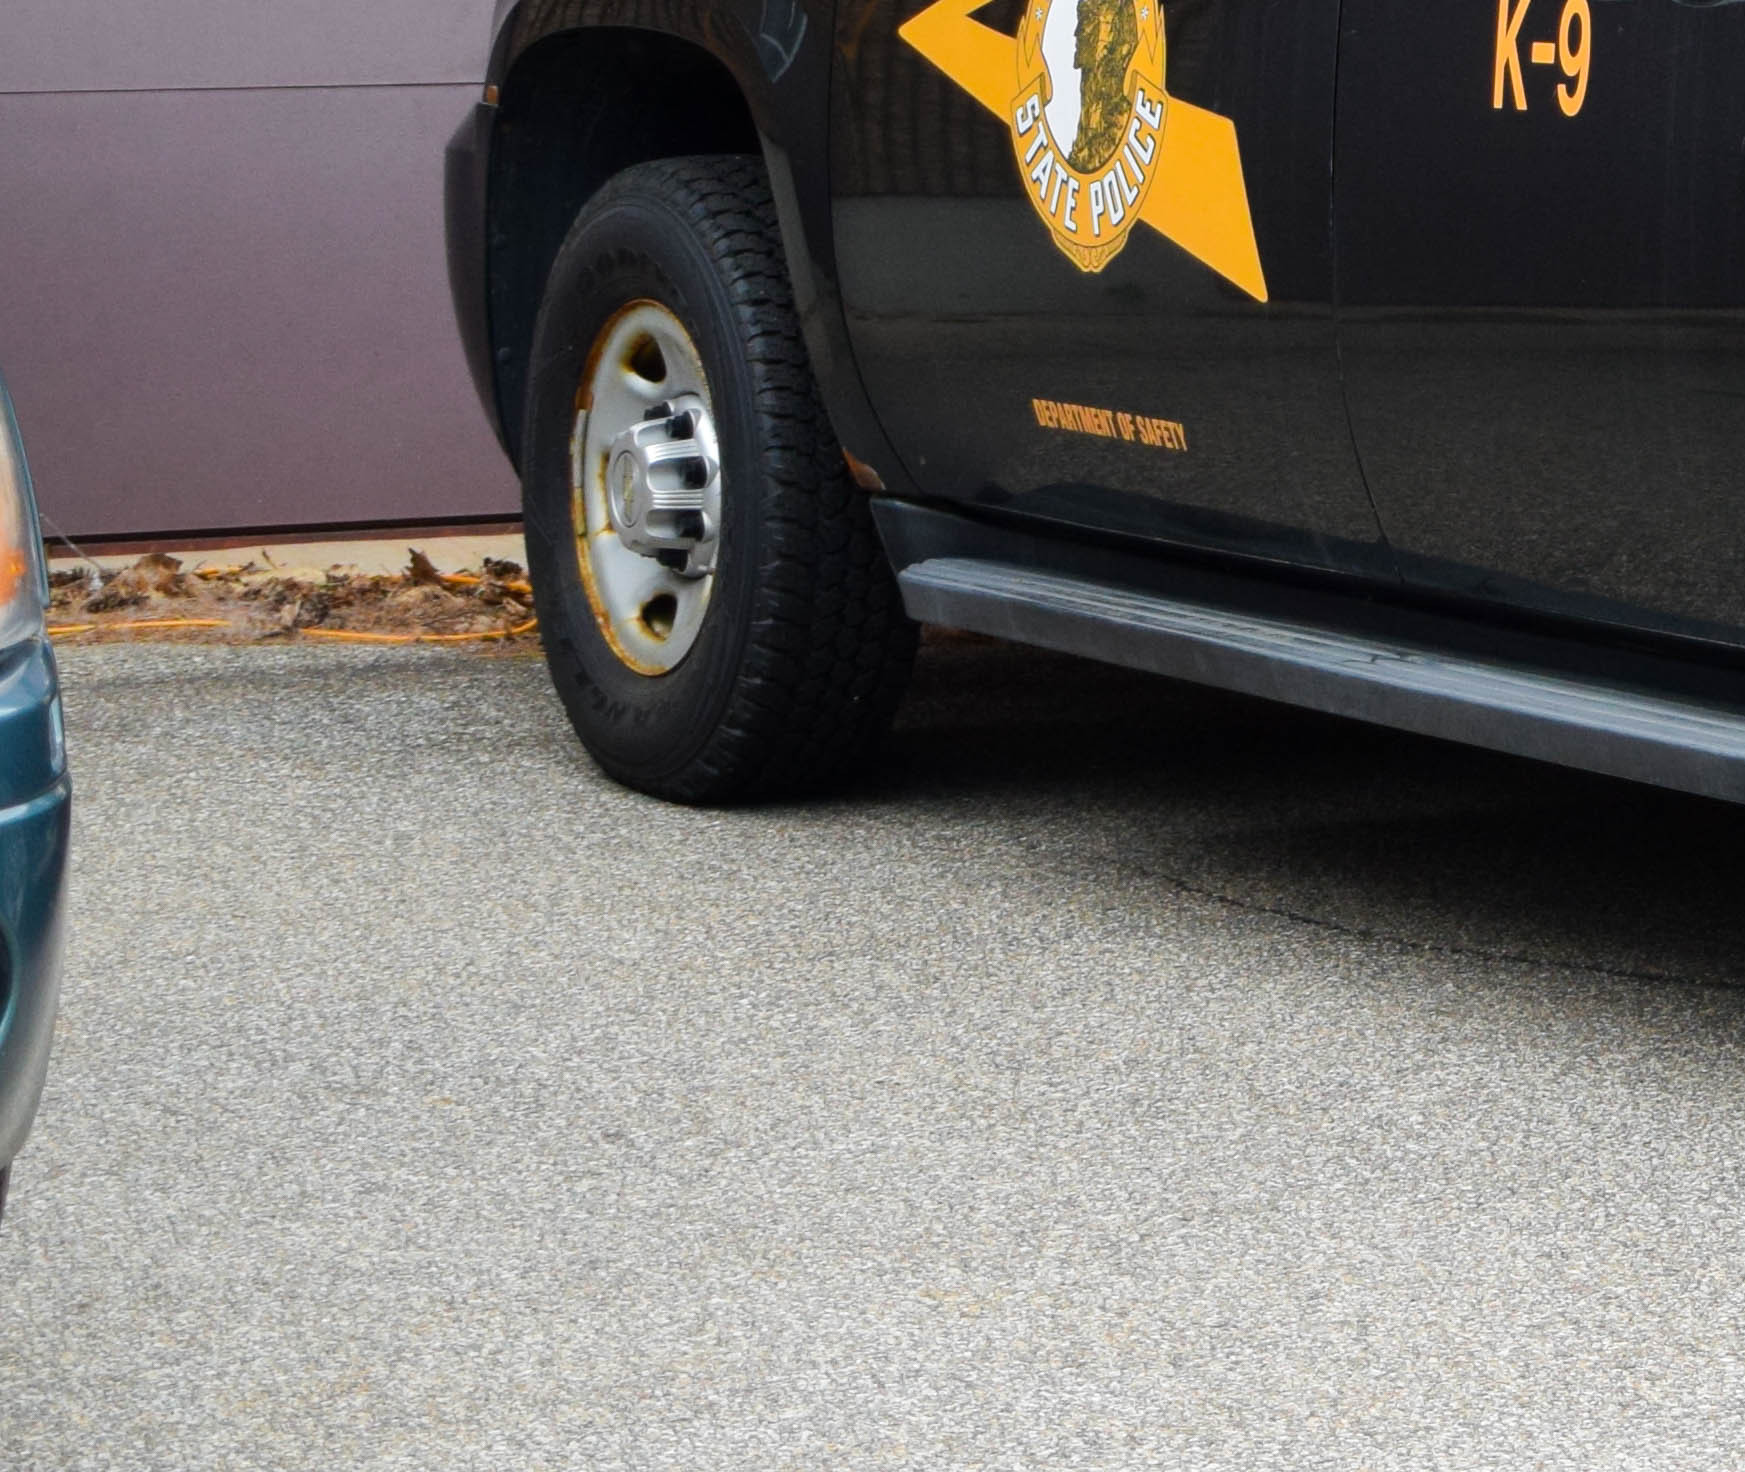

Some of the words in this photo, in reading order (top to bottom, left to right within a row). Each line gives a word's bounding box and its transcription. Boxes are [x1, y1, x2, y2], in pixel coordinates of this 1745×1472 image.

[1016, 92, 1079, 232] STATE
[1089, 88, 1164, 235] POLICE
[1032, 398, 1118, 439] DEPARTMENT
[1116, 412, 1135, 441] OF
[1135, 415, 1188, 452] SAFETY
